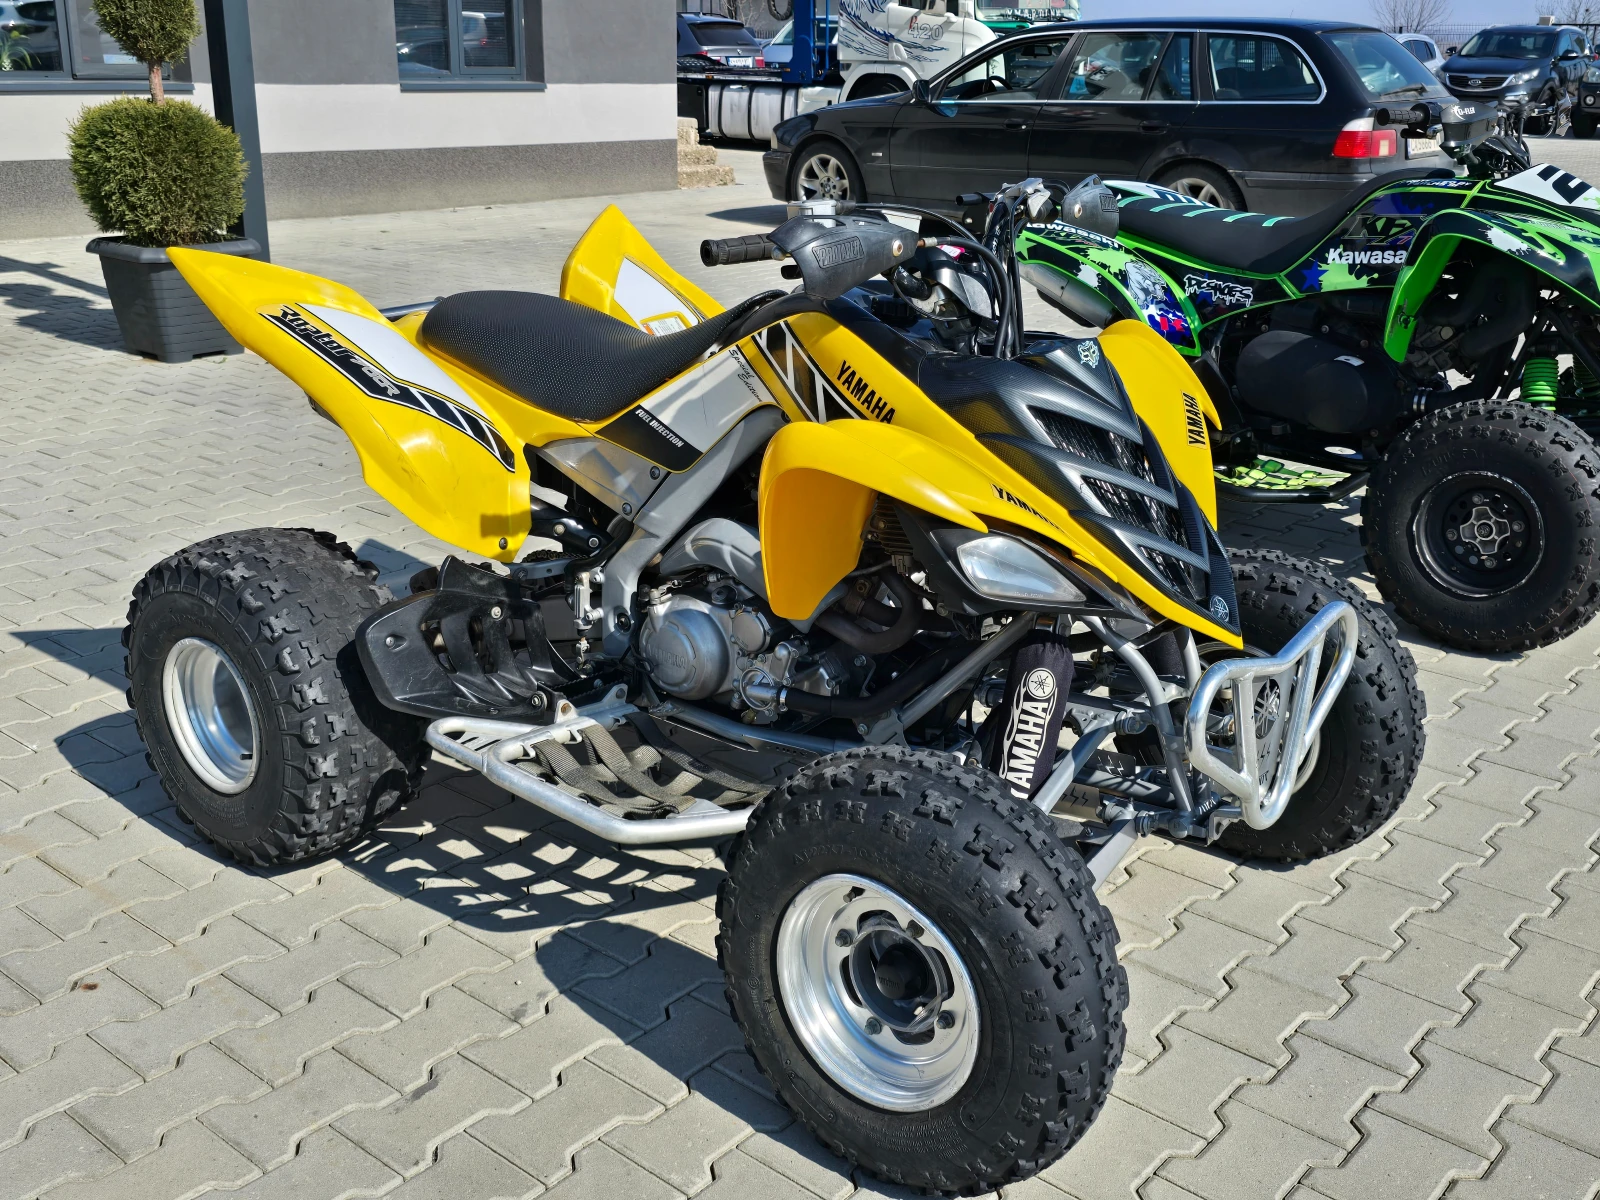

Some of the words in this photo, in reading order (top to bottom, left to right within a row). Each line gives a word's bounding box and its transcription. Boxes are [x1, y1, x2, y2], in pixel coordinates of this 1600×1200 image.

[908, 23, 944, 41] 420
[1026, 221, 1120, 249] awasaki
[1327, 248, 1408, 264] Kawasa
[728, 349, 755, 379] Special
[737, 373, 762, 402] Edition
[836, 359, 896, 425] YAMAHA
[635, 408, 652, 424] FUEL
[649, 419, 685, 448] INJECTION
[1182, 392, 1206, 446] YAMAHA
